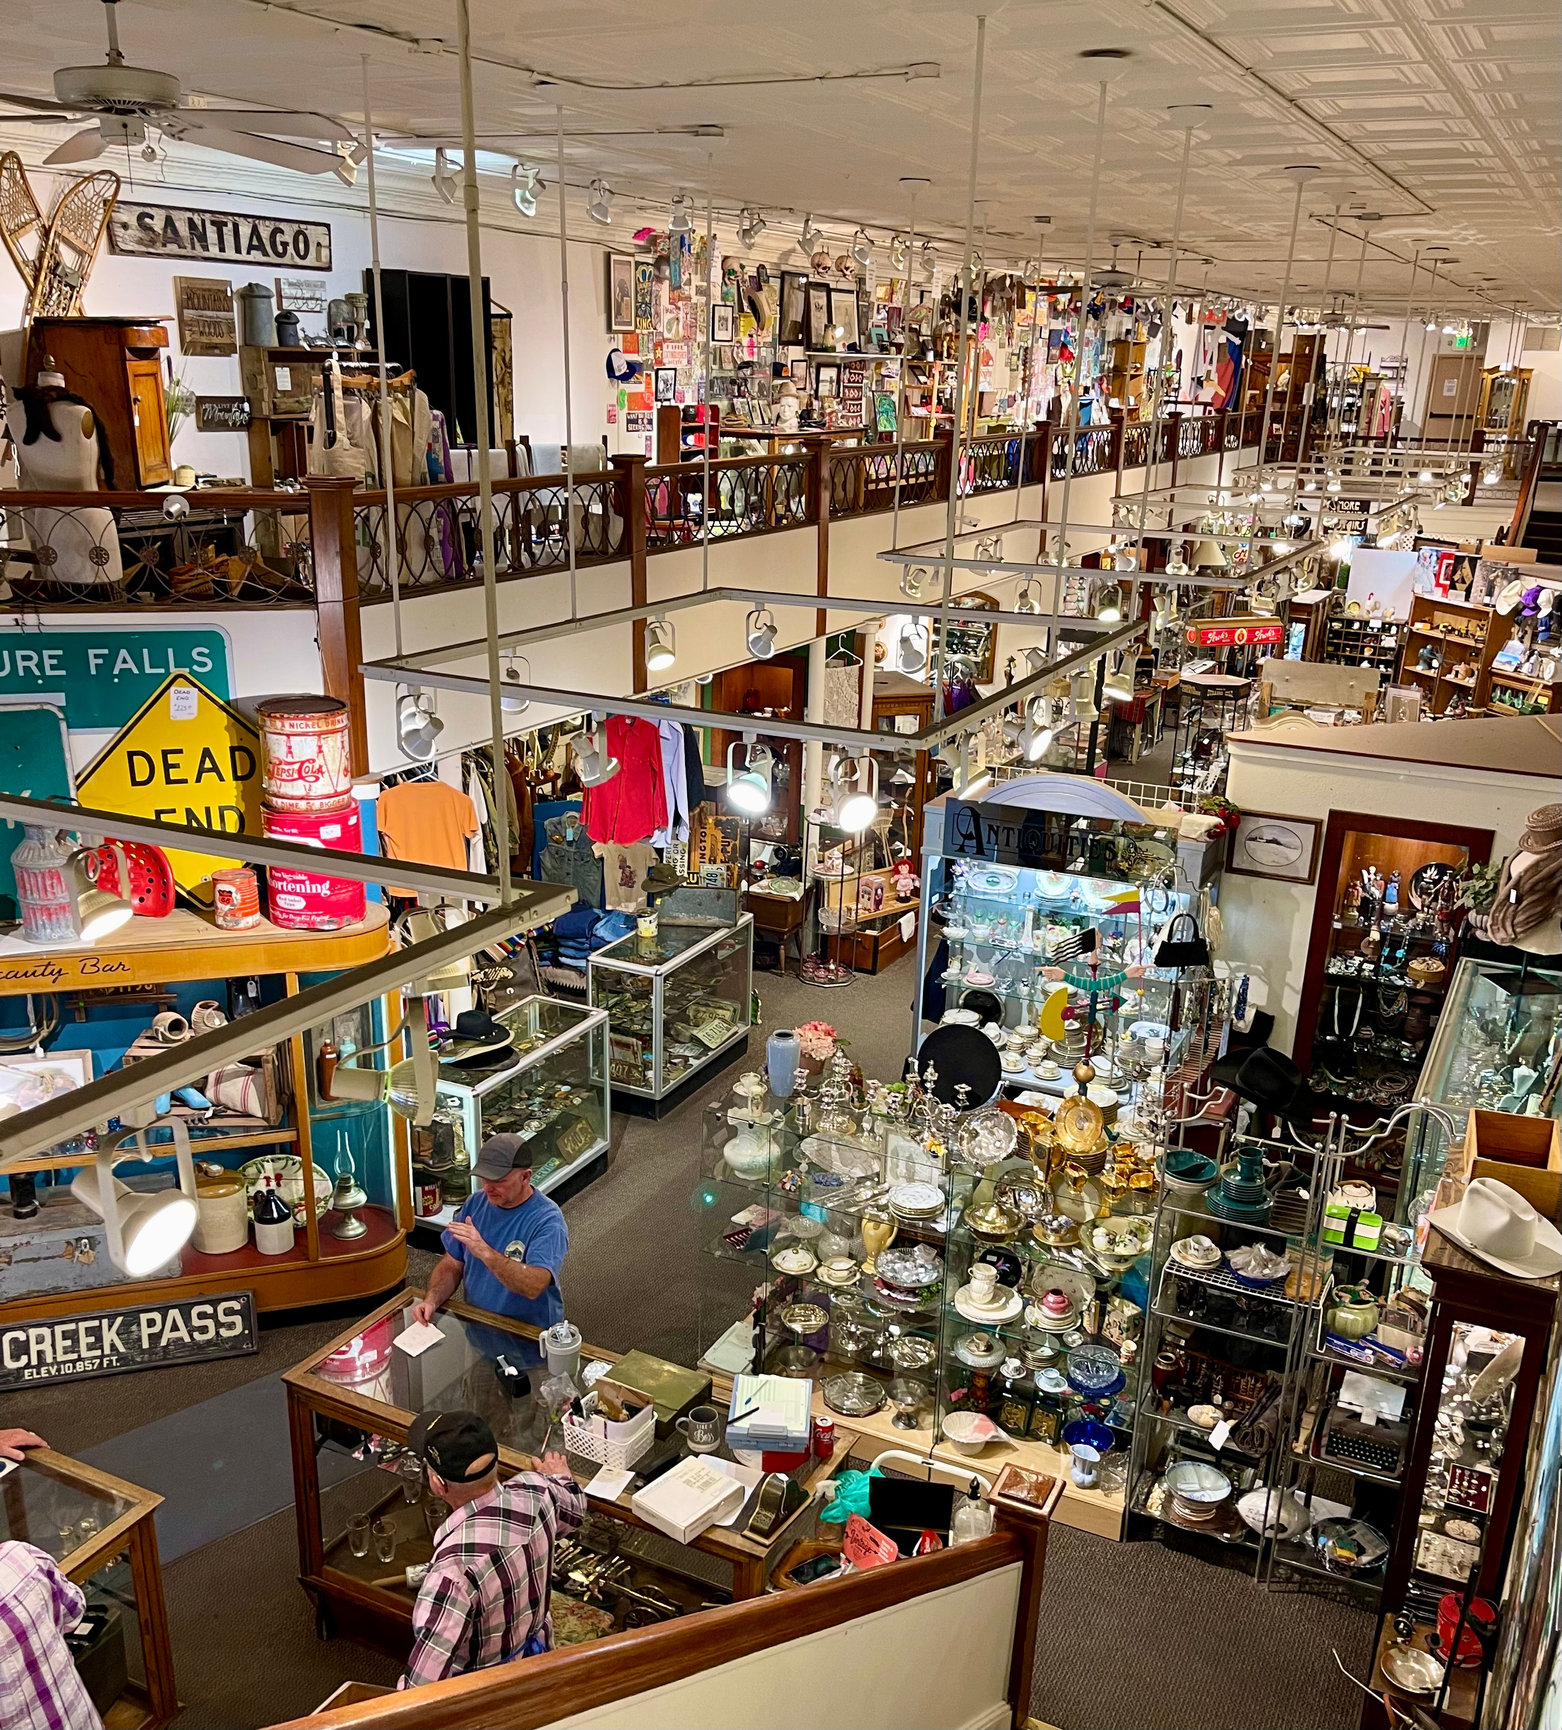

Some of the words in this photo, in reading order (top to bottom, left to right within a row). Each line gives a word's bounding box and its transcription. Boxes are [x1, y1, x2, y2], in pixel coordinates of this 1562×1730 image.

[136, 211, 310, 260] SANTIAGO
[88, 647, 213, 673] FALLS
[289, 719, 320, 729] NICKEL
[127, 746, 256, 787] DEAD
[79, 957, 131, 975] Bar
[2, 1316, 126, 1369] CREEK
[103, 1355, 120, 1368] FT.
